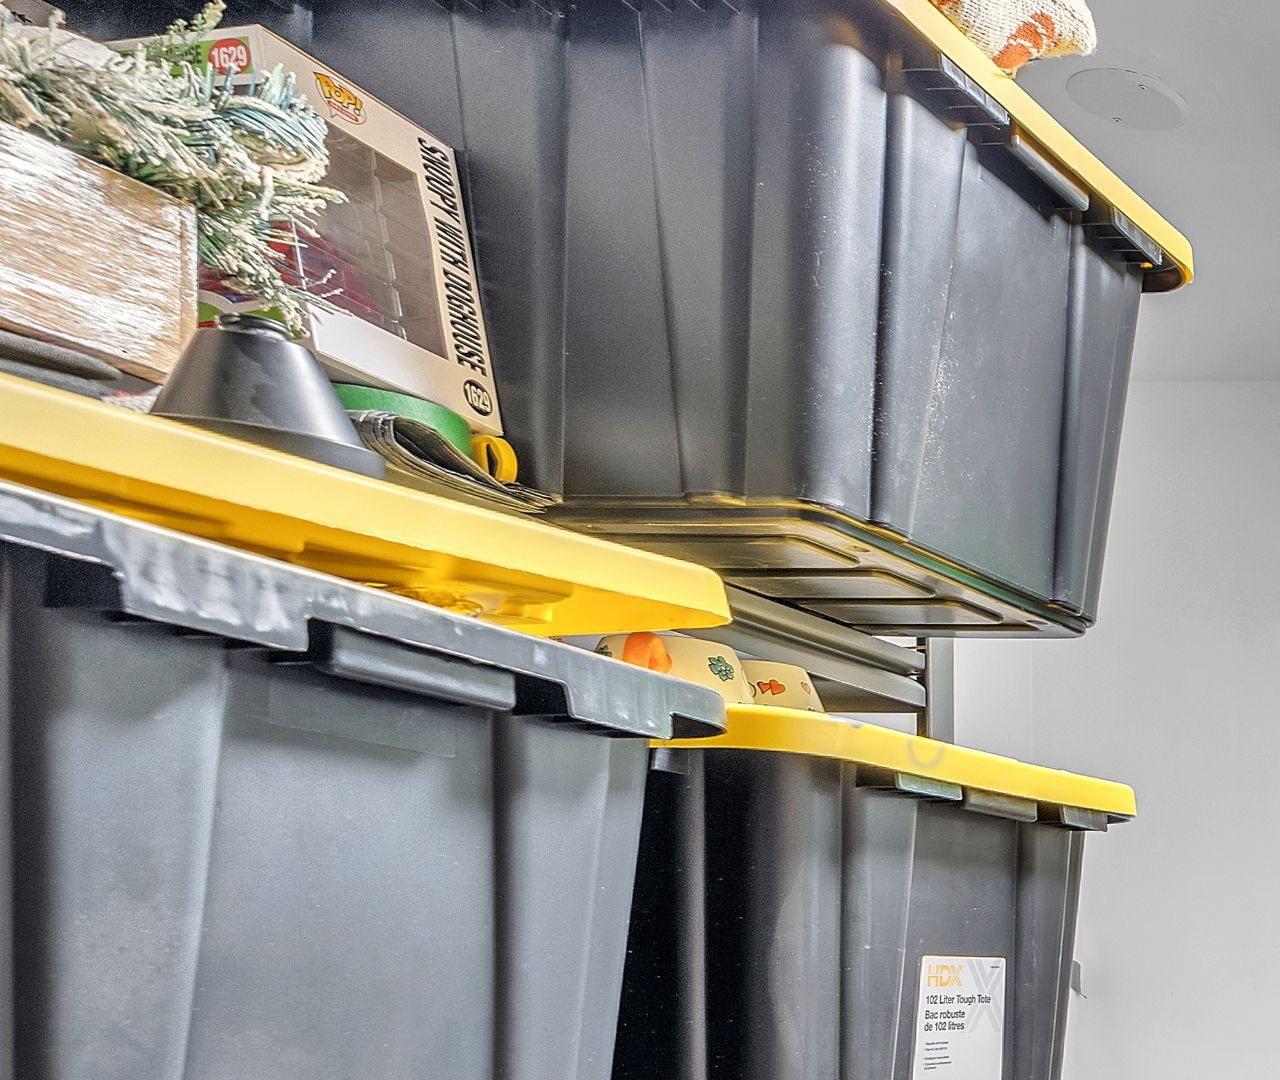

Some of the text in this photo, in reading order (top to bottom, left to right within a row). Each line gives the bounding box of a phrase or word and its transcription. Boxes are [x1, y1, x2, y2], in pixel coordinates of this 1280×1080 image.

[211, 47, 248, 71] 1629
[418, 136, 488, 379] SNOOPY WITH DOGHOUSE
[465, 383, 491, 415] 1629
[926, 965, 963, 987] HDX
[926, 993, 992, 1006] 102 Liter Tough Tote
[925, 1009, 966, 1020] Bac robuste
[924, 1021, 965, 1032] de 102 litres
